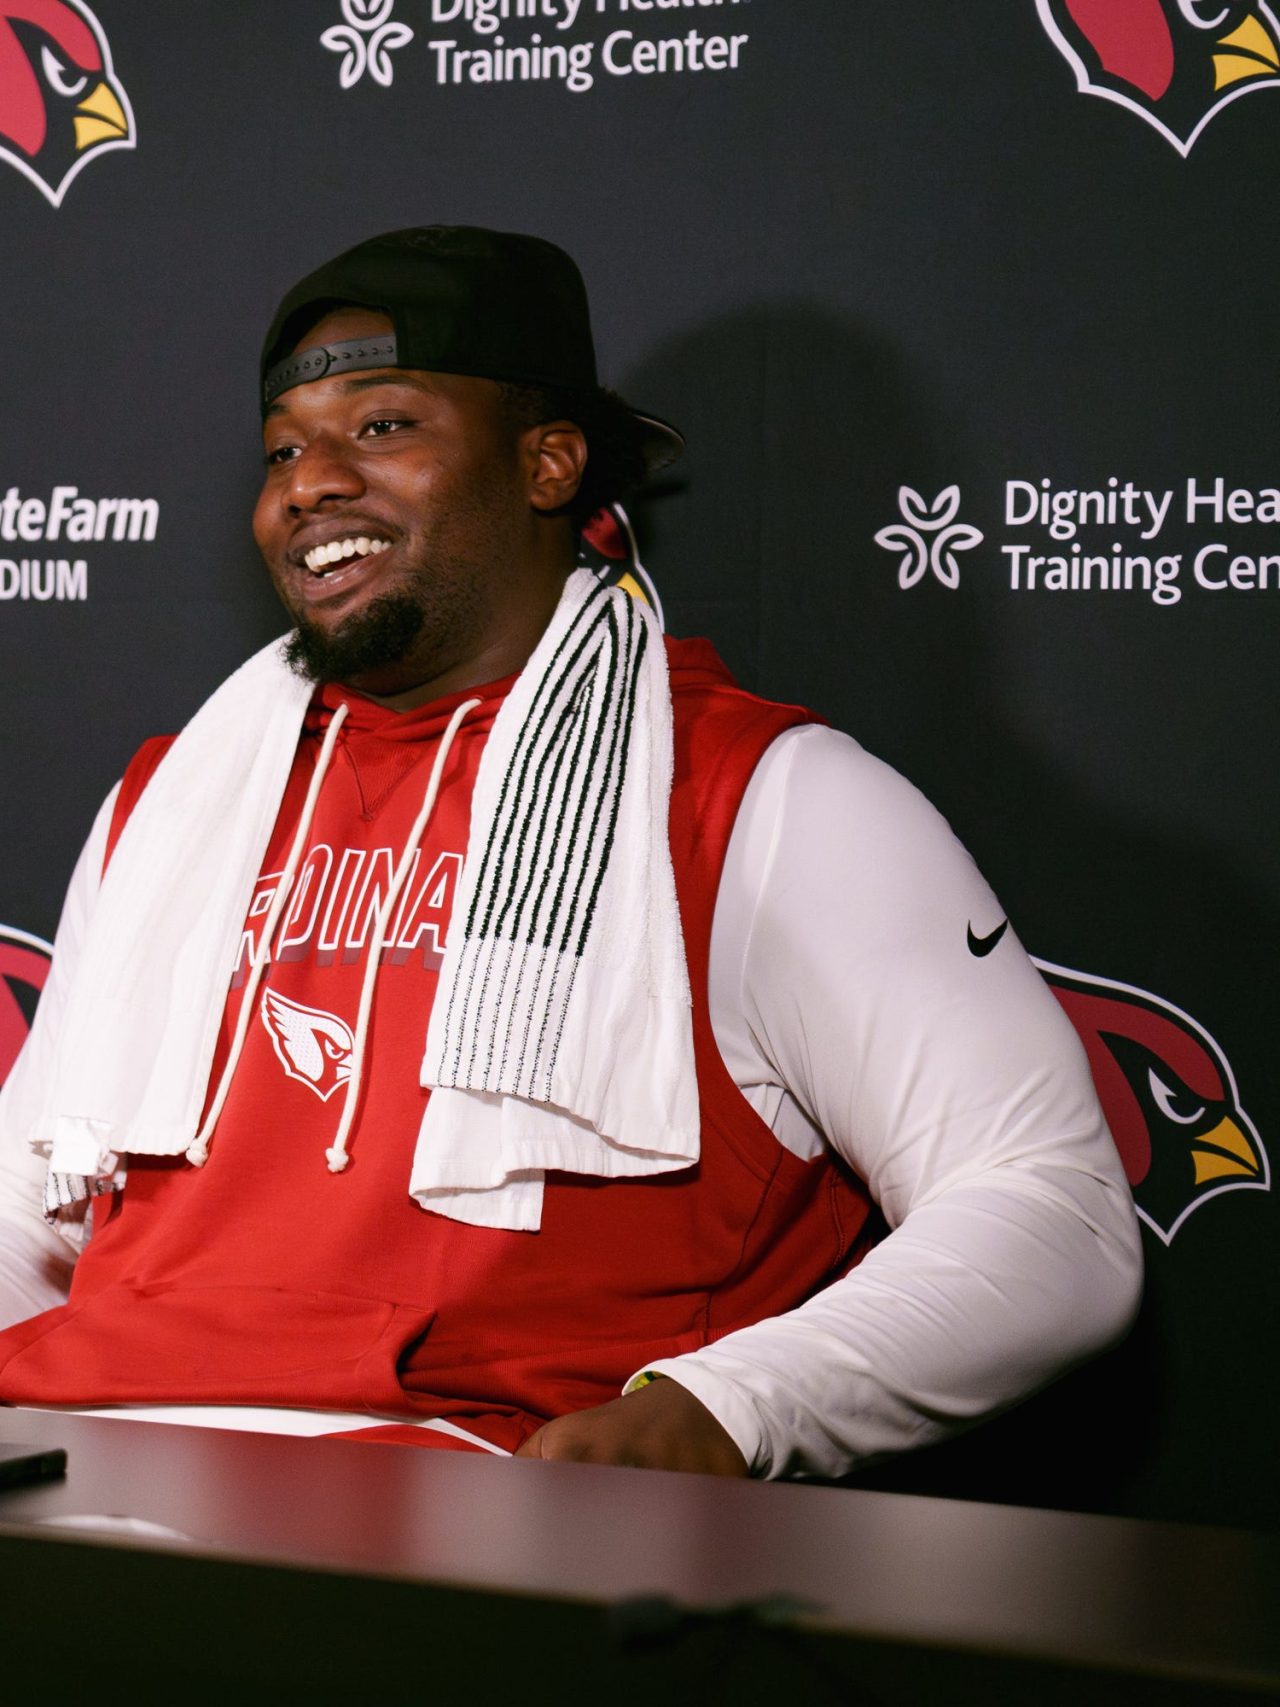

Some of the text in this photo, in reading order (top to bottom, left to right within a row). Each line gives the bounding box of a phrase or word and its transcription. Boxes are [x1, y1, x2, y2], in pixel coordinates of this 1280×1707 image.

[428, 29, 749, 93] Training Center
[1005, 476, 1174, 541] Dignity
[1000, 542, 1183, 606] Training
